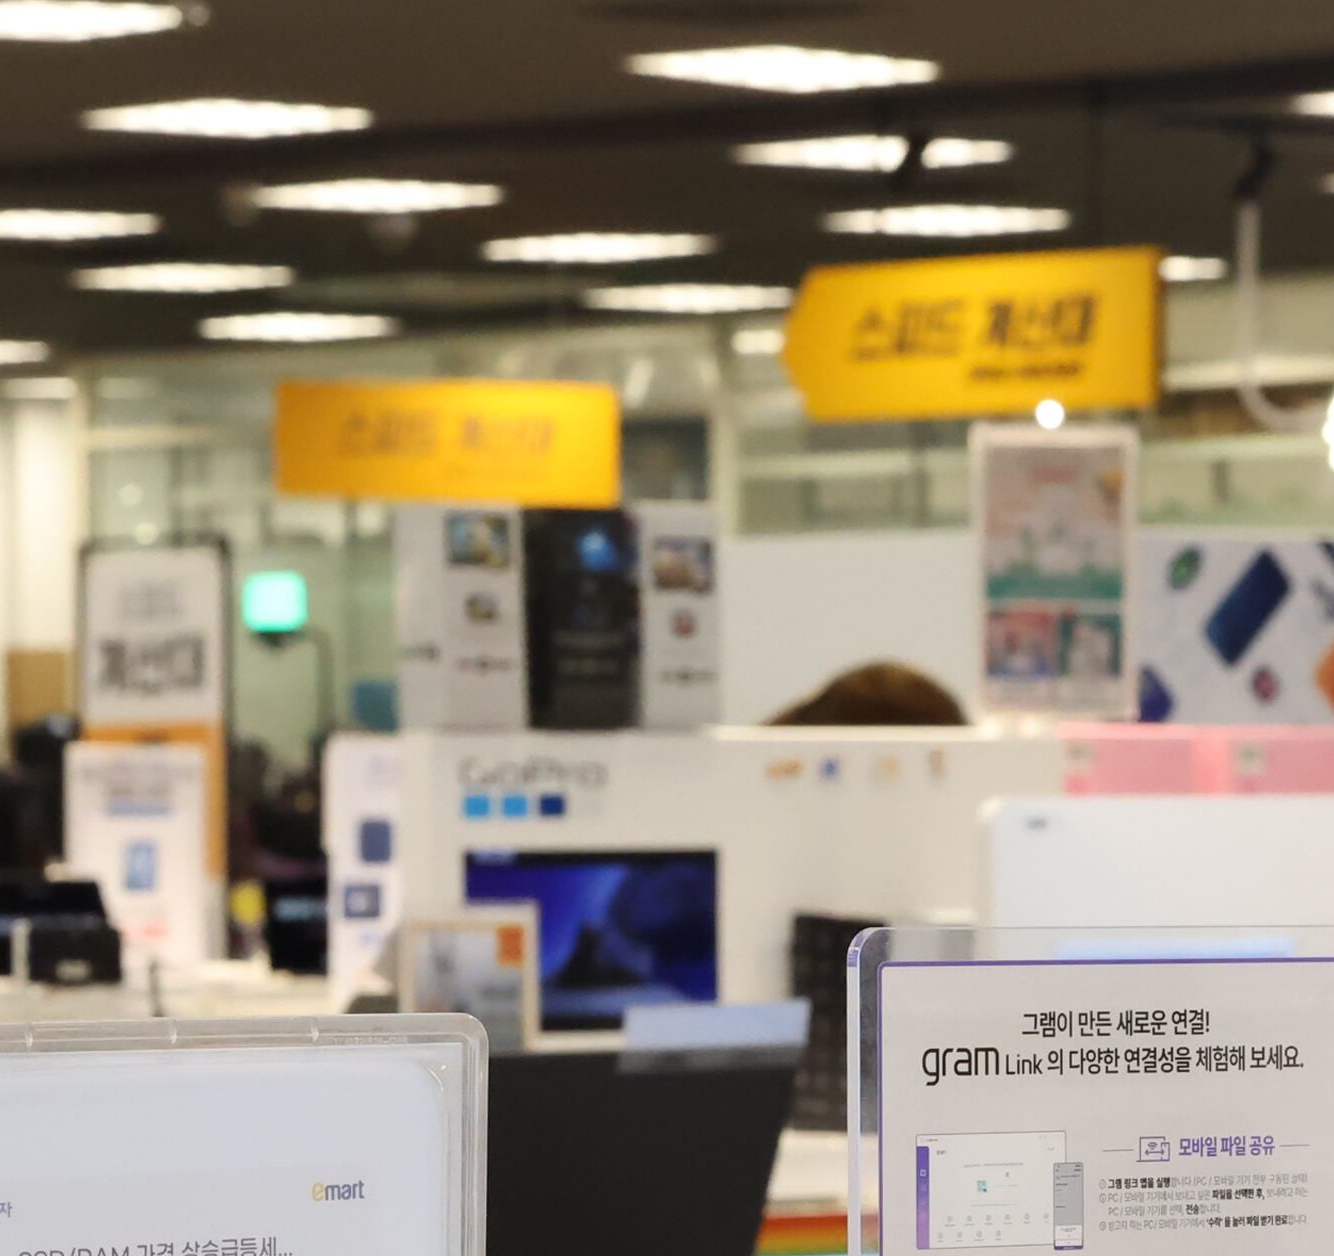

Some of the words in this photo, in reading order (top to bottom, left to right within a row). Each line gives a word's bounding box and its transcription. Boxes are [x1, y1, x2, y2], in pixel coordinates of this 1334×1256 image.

[1022, 1011, 1072, 1037] 그램이
[1078, 1011, 1112, 1037] 만든
[1116, 1010, 1167, 1036] 새로운
[1171, 1009, 1210, 1035] 연결!
[921, 1047, 999, 1086] gram
[1006, 1053, 1043, 1075] Link
[1047, 1048, 1064, 1075] 의
[1069, 1048, 1120, 1074] 다양한
[1124, 1047, 1191, 1073] 연결성을
[1195, 1045, 1245, 1071] 체험해
[1250, 1045, 1304, 1070] 보세요.
[1178, 1136, 1218, 1157] 모바일
[1220, 1135, 1246, 1157] 파일
[1249, 1135, 1276, 1156] 공유
[311, 1180, 365, 1201] emart
